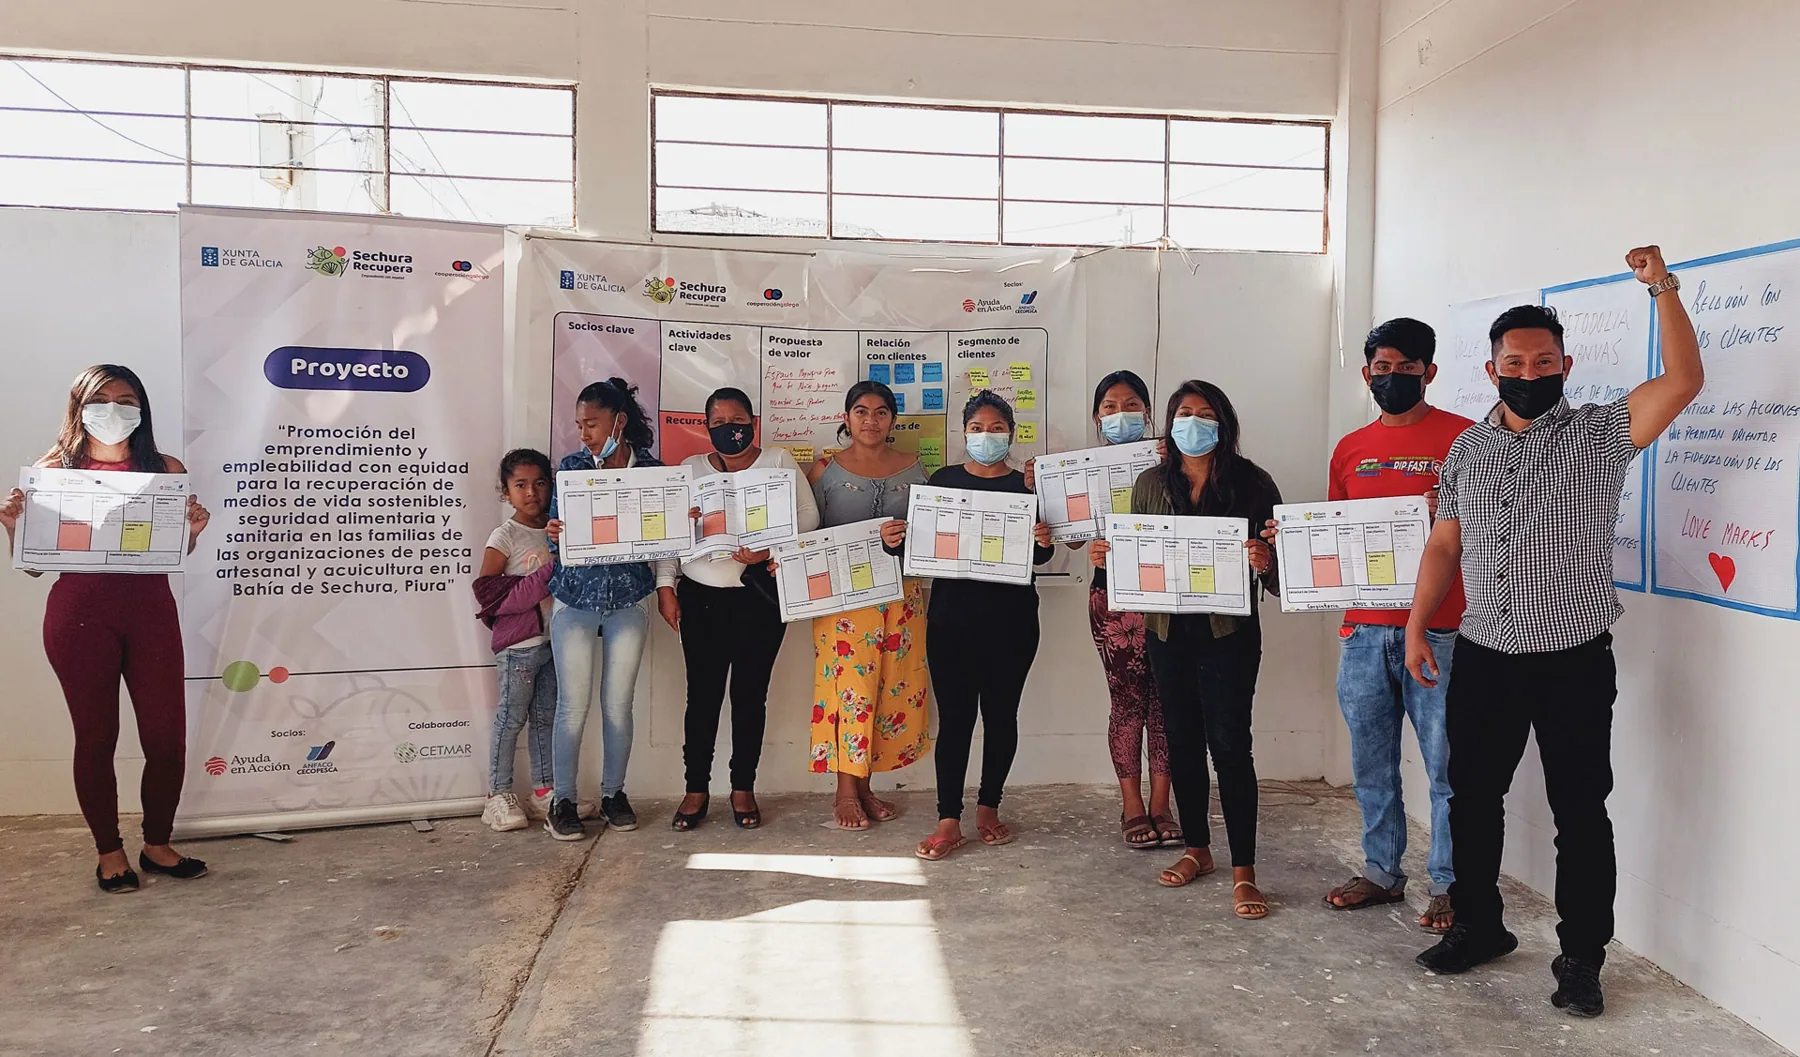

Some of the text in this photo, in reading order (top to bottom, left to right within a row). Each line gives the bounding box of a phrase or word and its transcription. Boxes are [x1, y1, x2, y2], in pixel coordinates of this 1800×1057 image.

[222, 249, 260, 258] XUNTA
[352, 250, 413, 264] Sechura
[222, 258, 283, 268] DE GALICIA
[353, 262, 413, 274] Recupera
[576, 273, 607, 283] XUNTA
[576, 282, 626, 293] DE GALICIA
[679, 281, 727, 294] Sechura
[679, 291, 727, 302] Recupera
[1761, 282, 1782, 306] CON
[977, 298, 1000, 308] Ayuda
[986, 303, 1012, 312] Acción
[568, 322, 635, 335] Socios clave
[668, 329, 732, 341] Actividades
[1720, 324, 1784, 350] CLIENTES
[668, 342, 698, 352] clave
[769, 335, 823, 348] Propuesta
[866, 338, 910, 348] Relación
[958, 336, 1020, 347] Segmento de
[768, 348, 811, 358] de valor
[866, 352, 927, 361] con clientes
[958, 350, 996, 358] clientes
[290, 358, 410, 380] Proyecto
[1589, 384, 1601, 400] DE
[1722, 401, 1745, 416] LAS
[908, 422, 920, 430] de
[388, 428, 416, 440] del
[264, 444, 428, 460] emprendimiento y
[1664, 448, 1678, 464] LA
[1746, 456, 1760, 470] DE
[1764, 456, 1784, 472] LOS
[222, 460, 469, 476] empleabilidad con equidad
[237, 478, 454, 492] para la recuperación de
[1671, 471, 1720, 494] CLIENTES
[224, 495, 467, 508] medios de vida sostenibles,
[238, 512, 450, 528] seguridad alimentaria y
[1682, 508, 1776, 550] LOVE MARKS
[226, 529, 463, 543] sanitaria en las familias de
[217, 546, 472, 562] las organizaciones de pesca
[216, 562, 472, 580] artesanal y acuicultura en la
[233, 581, 284, 596] Bahía
[291, 582, 314, 595] de
[320, 581, 398, 594] Sechura,
[408, 720, 470, 730] Colaborador:
[271, 730, 306, 738] Socios:
[420, 744, 472, 756] CETMAR
[231, 754, 270, 766] Ayuda
[248, 762, 290, 773] Acción
[296, 766, 338, 775] CECOPESCA
